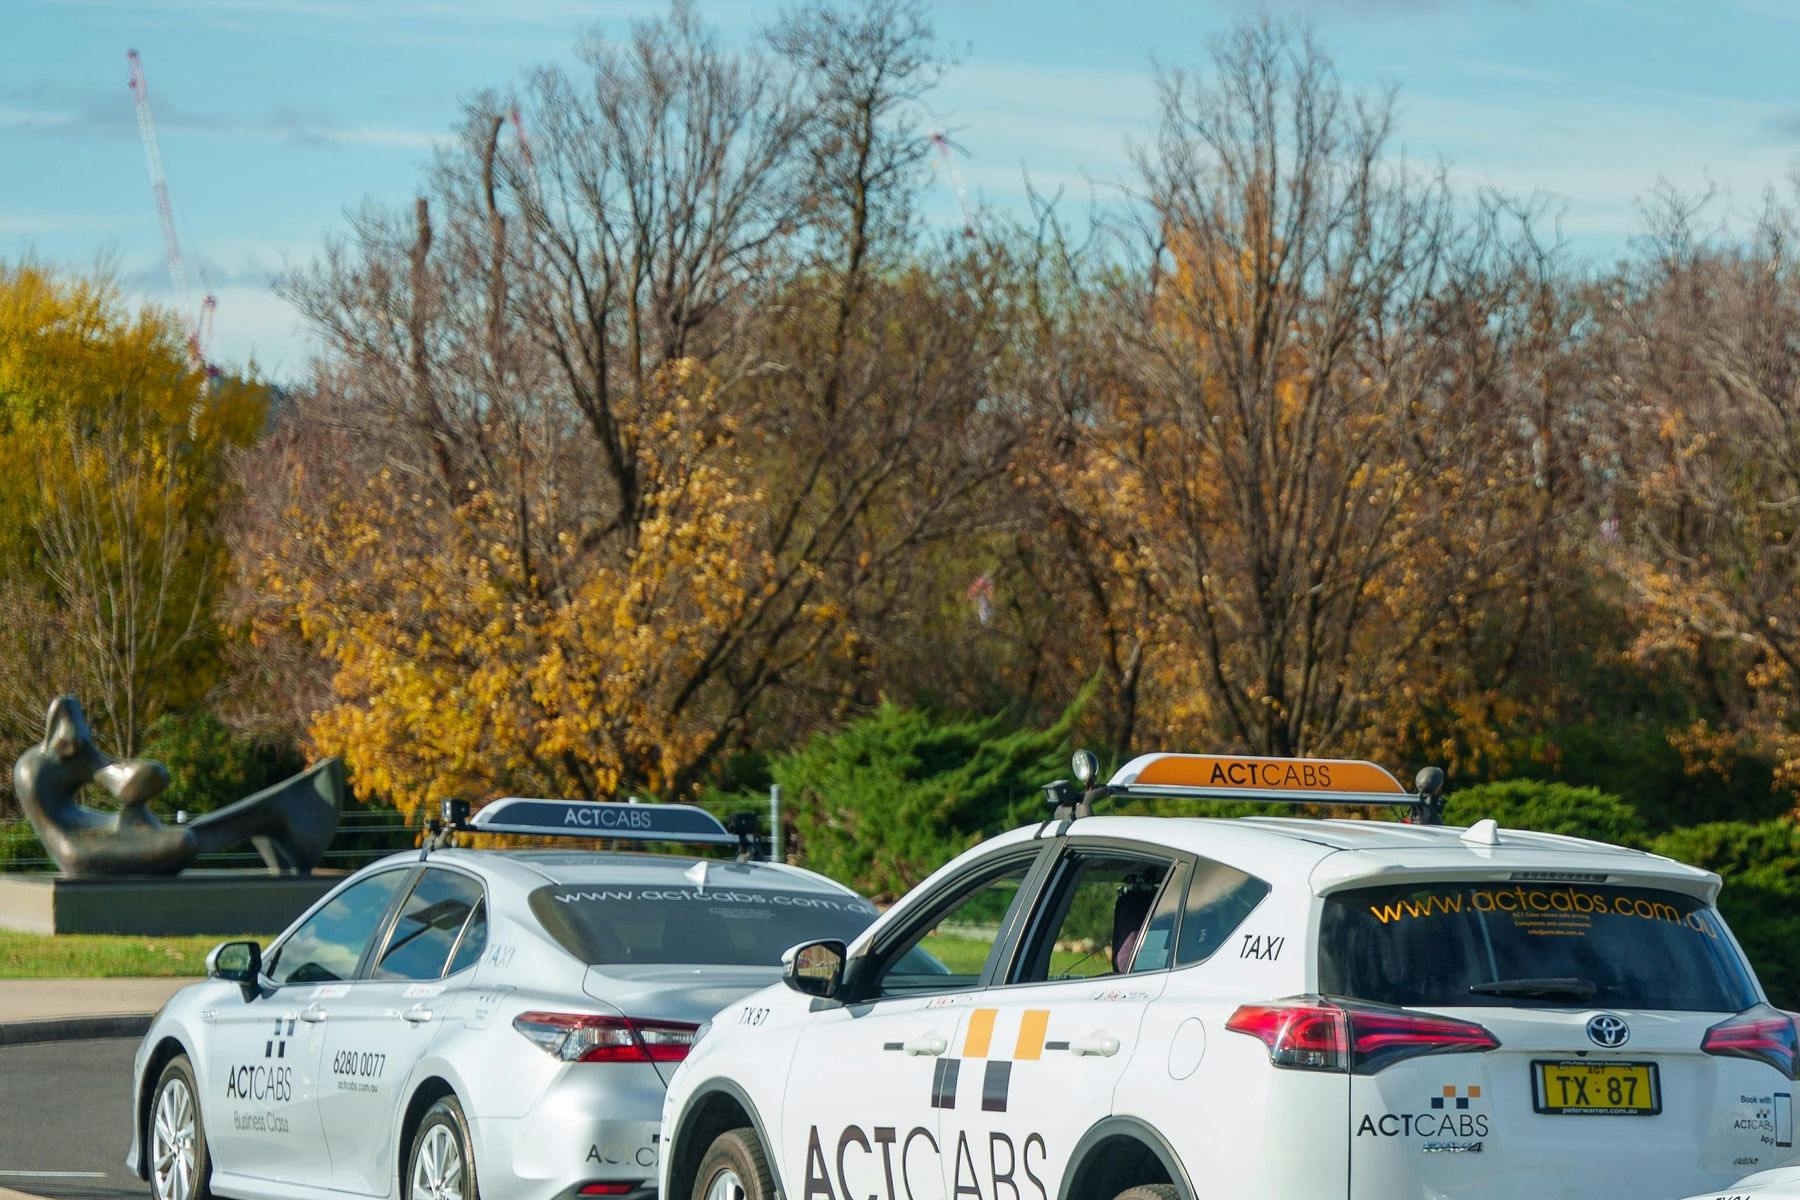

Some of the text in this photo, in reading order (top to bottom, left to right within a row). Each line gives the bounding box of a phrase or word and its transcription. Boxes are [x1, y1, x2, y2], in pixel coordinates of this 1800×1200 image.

[1210, 762, 1331, 787] ACTCABS
[564, 807, 652, 829] ACTCABS
[554, 888, 868, 914] www.actcabs.com.a
[1370, 885, 1718, 939] www.actcabs.com.au
[1240, 934, 1285, 961] TAXI
[333, 1050, 386, 1078] 6280 0077
[227, 1065, 292, 1101] ACTCABS
[1356, 1113, 1489, 1137] ACTCABS
